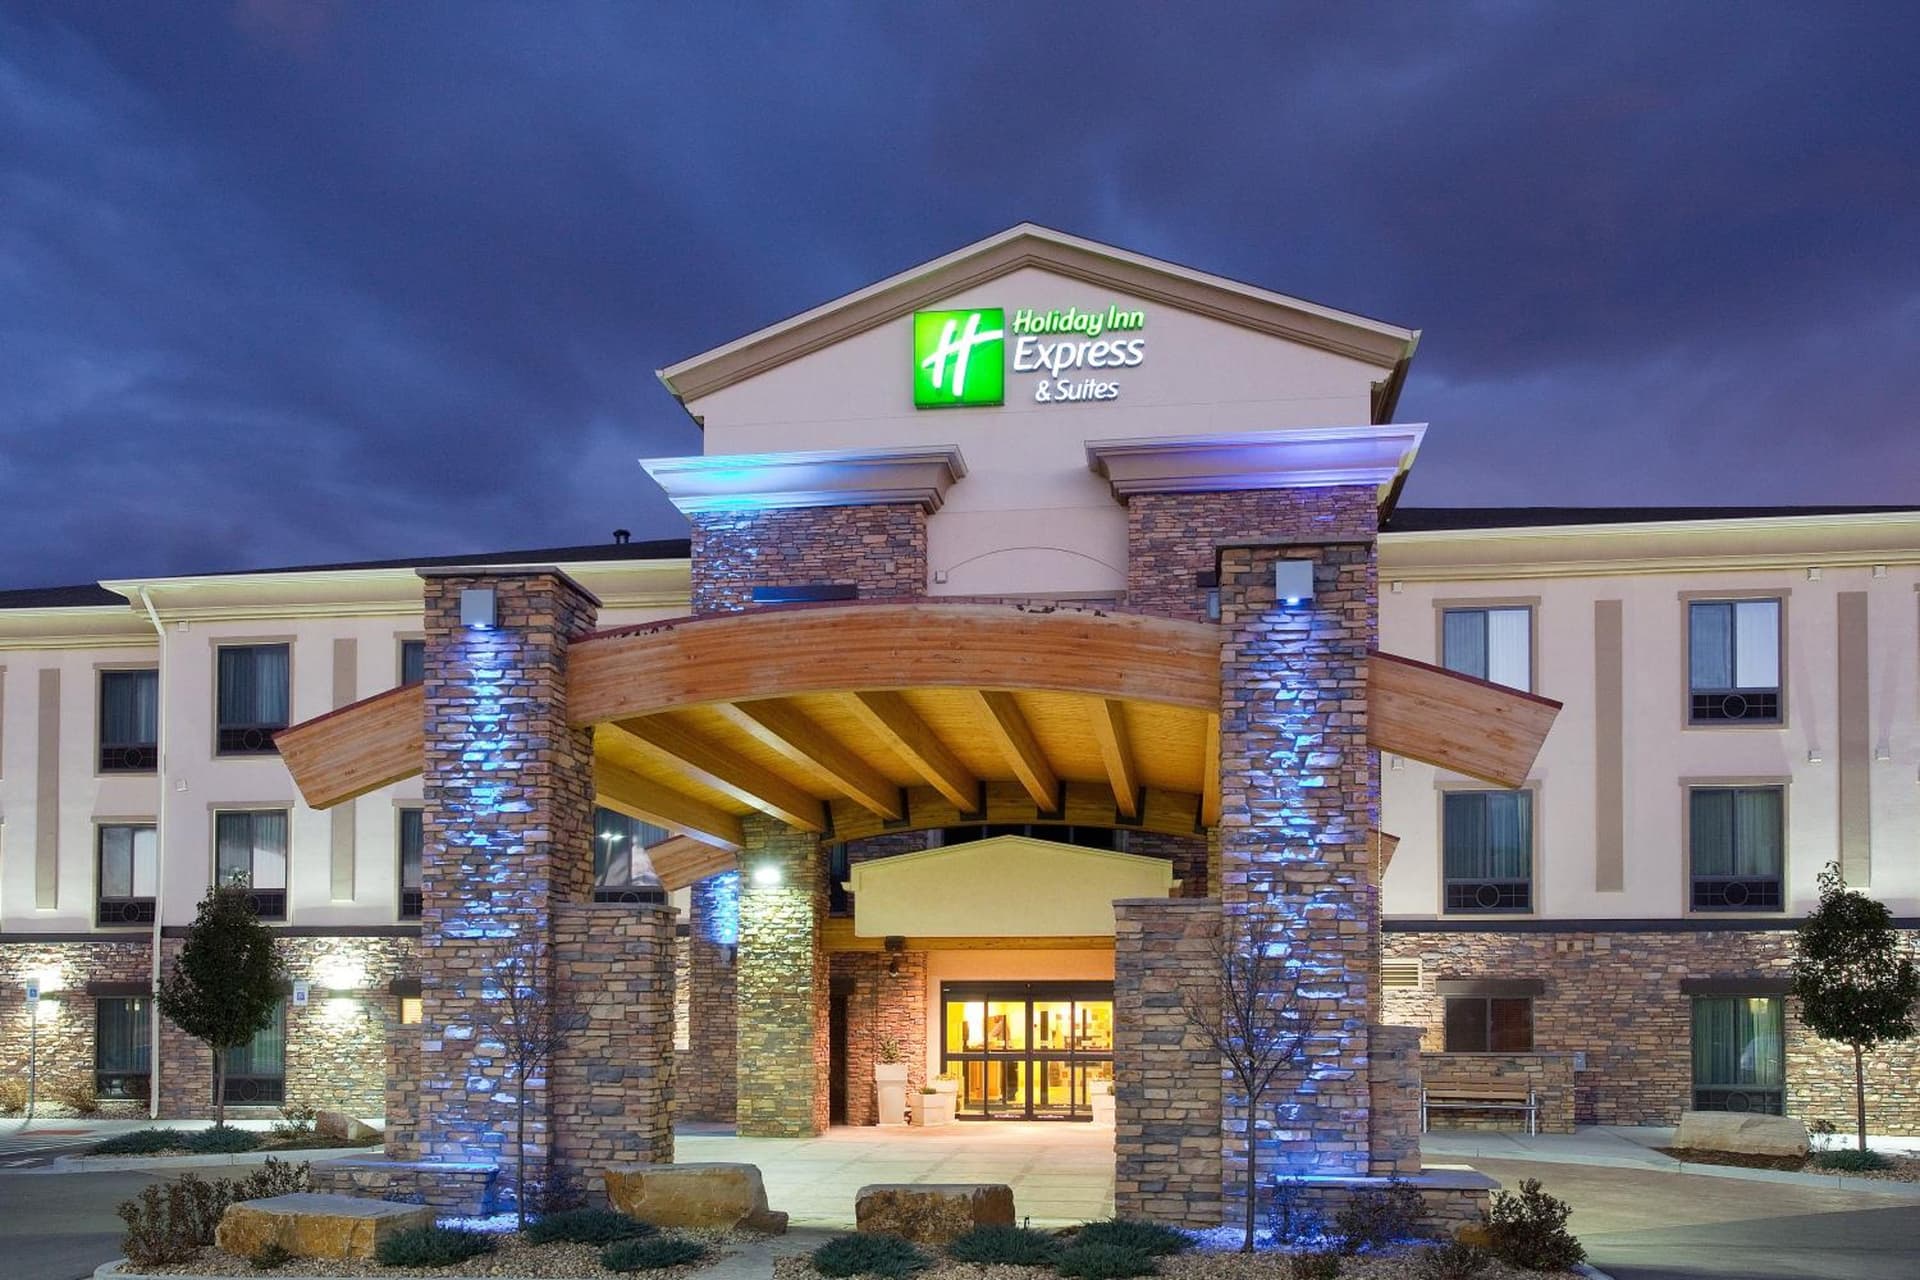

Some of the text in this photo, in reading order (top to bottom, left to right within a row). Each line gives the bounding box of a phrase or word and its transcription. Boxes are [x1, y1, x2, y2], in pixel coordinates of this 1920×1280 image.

[1013, 305, 1145, 336] Holiday Inn
[922, 313, 1003, 397] H
[1013, 336, 1145, 378] Express
[1035, 379, 1119, 401] & Suites
